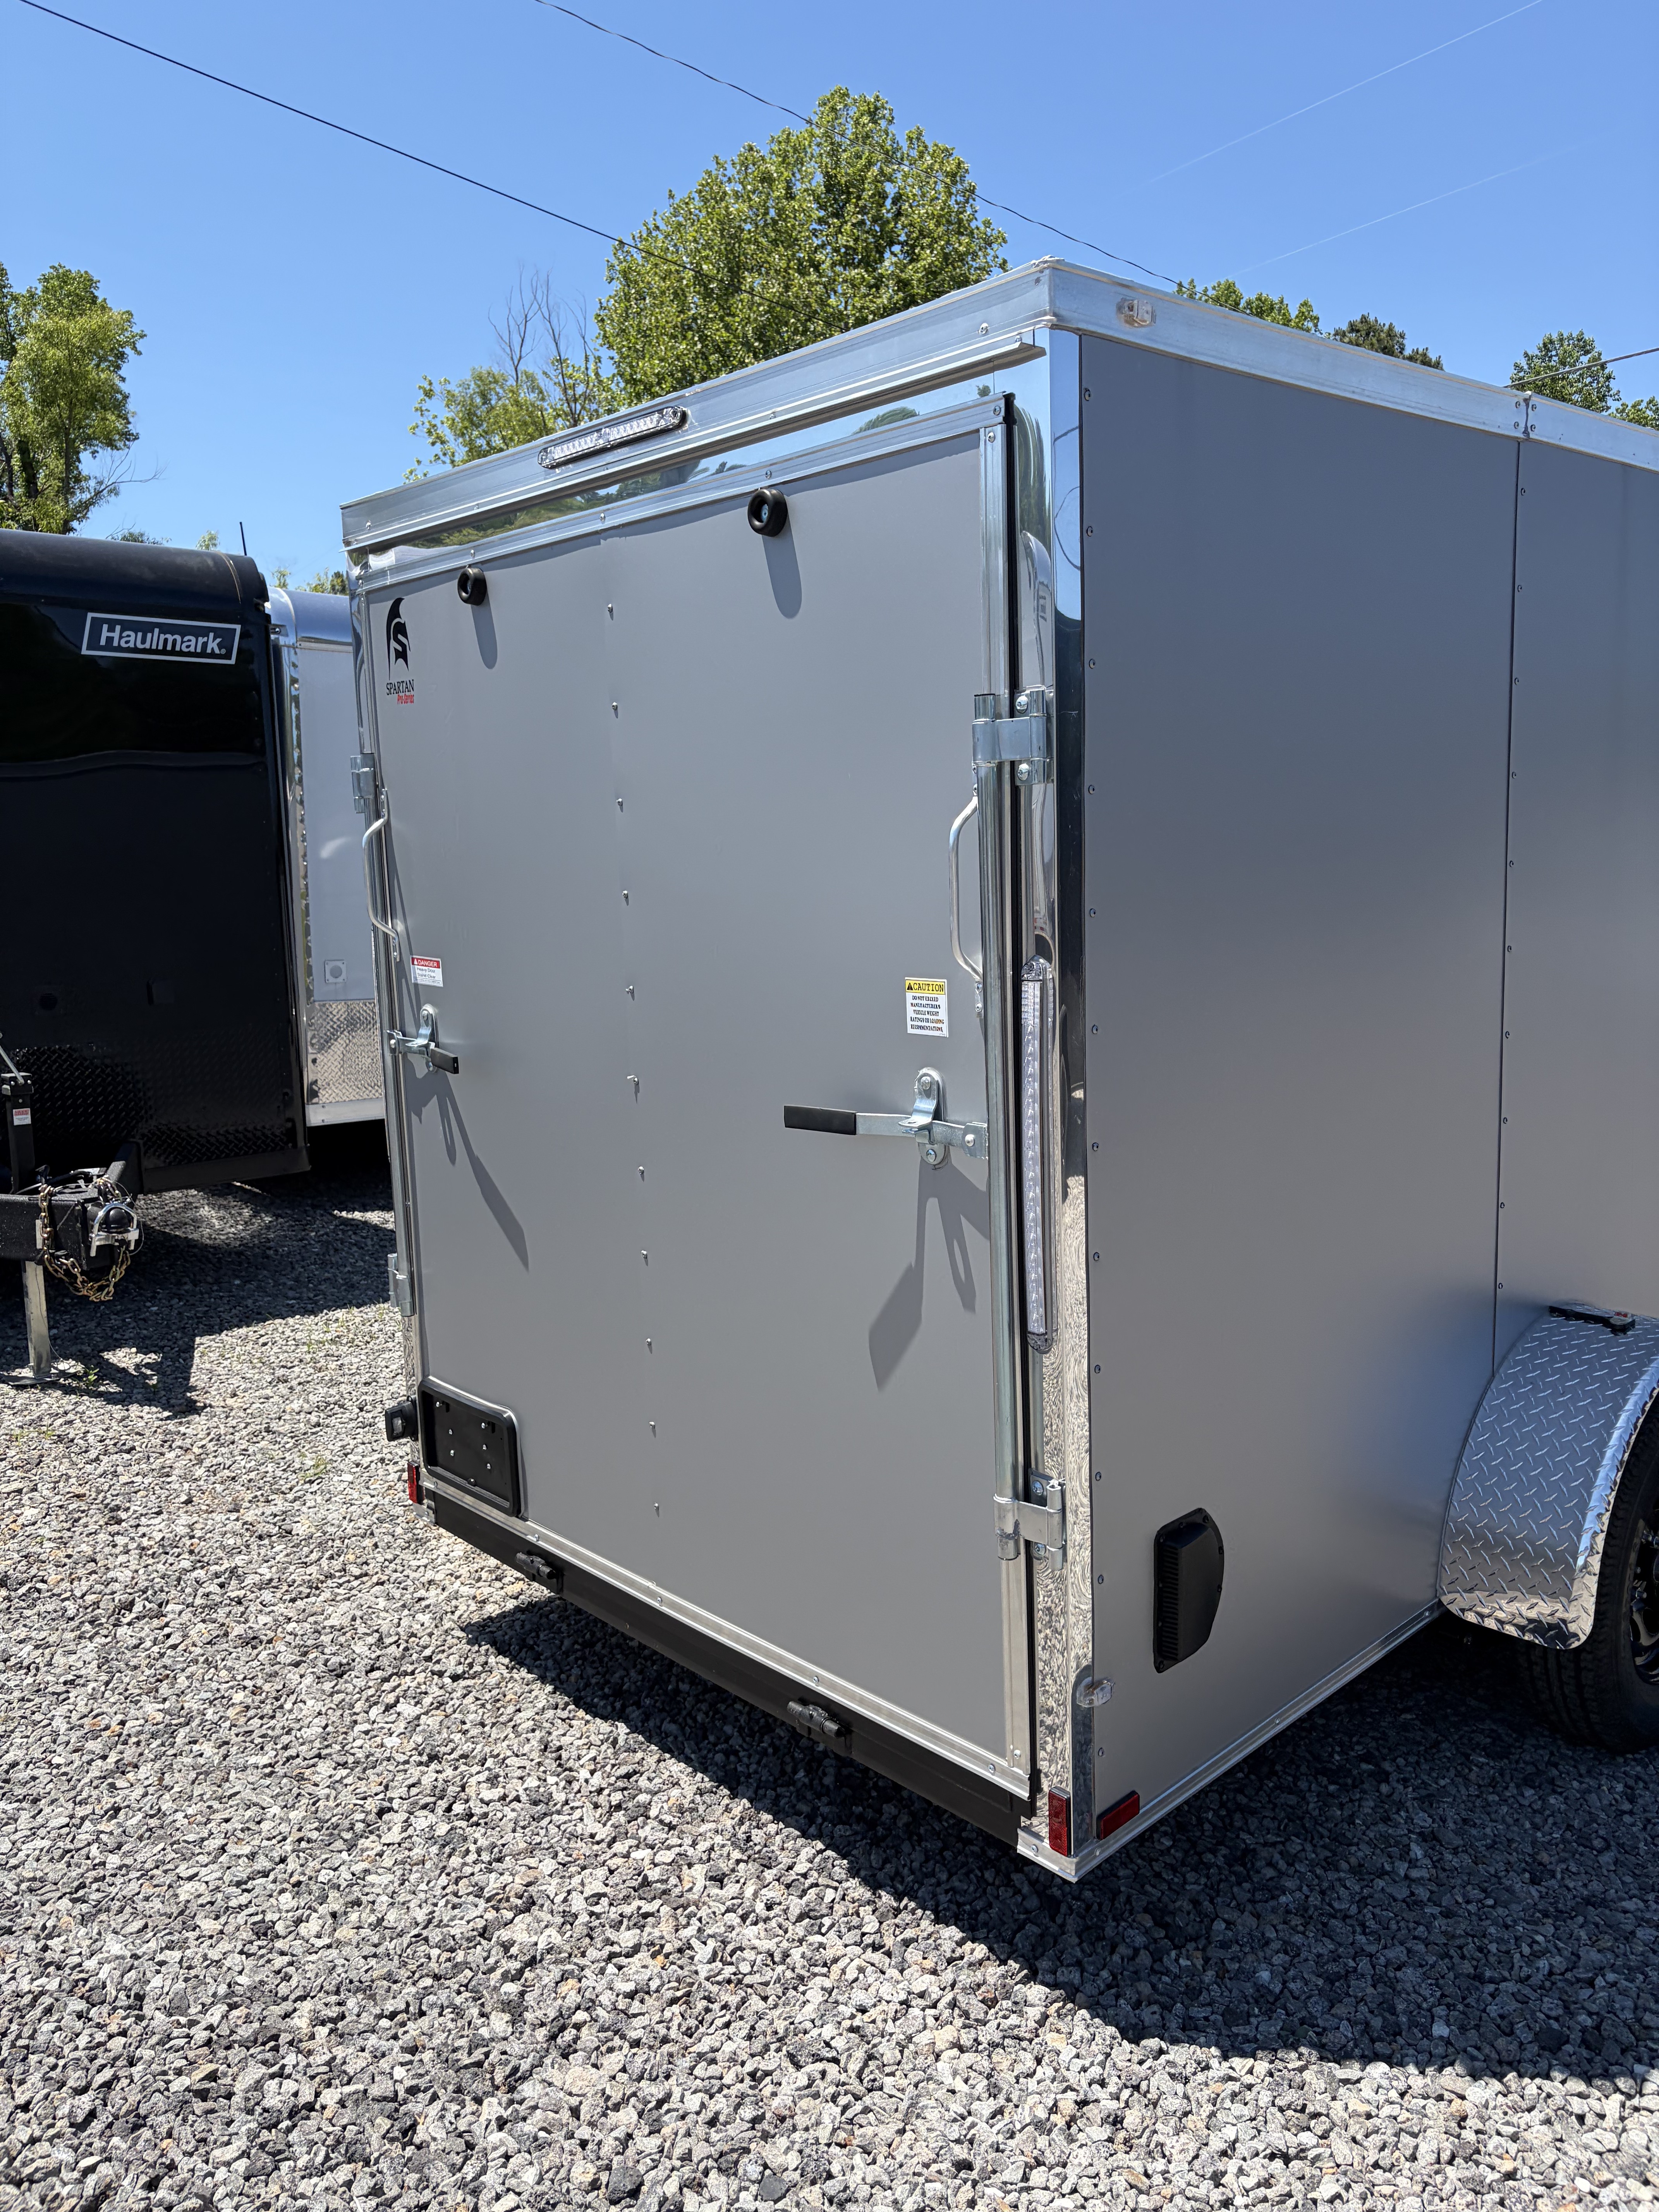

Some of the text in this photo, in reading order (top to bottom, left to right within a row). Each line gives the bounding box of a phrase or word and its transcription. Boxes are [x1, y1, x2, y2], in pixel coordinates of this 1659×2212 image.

[386, 679, 414, 696] SPARTAN
[913, 983, 944, 992] CAUTION
[910, 1024, 943, 1032] RECOMMENDATIONS
